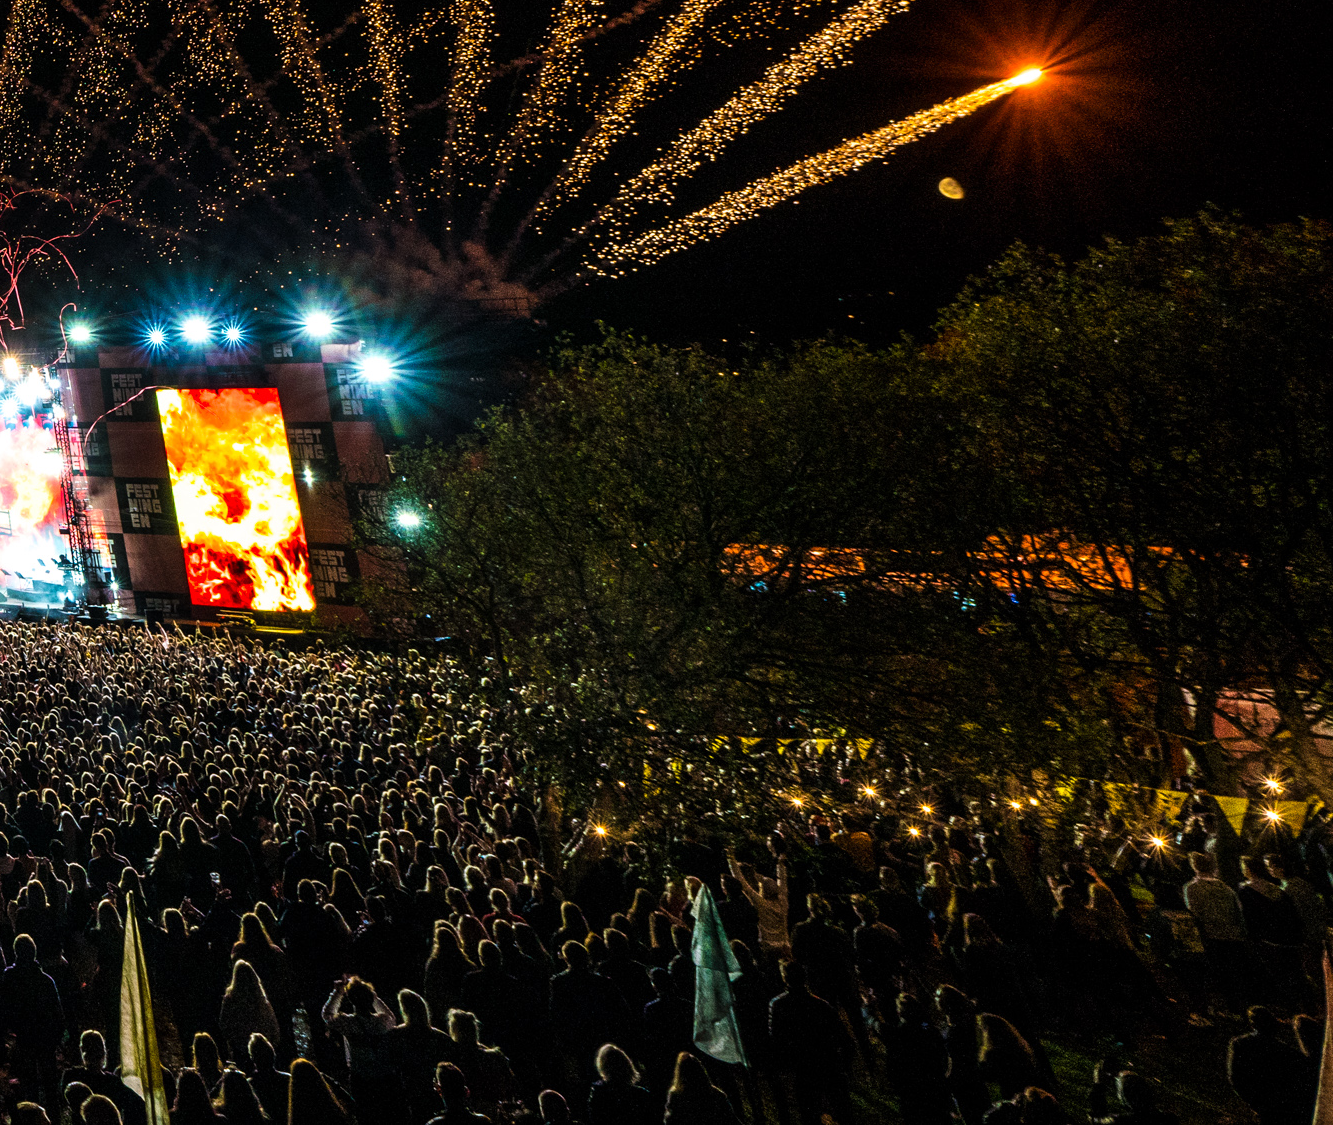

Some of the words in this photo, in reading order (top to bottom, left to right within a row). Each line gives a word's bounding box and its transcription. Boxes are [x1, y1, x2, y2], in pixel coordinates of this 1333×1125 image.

[273, 343, 293, 358] EN
[111, 373, 142, 388] FEST
[112, 388, 144, 402] NING
[114, 402, 133, 416] EN
[341, 400, 364, 415] EN
[126, 483, 159, 499] FEST
[127, 498, 162, 514] NING
[130, 513, 152, 528] EN
